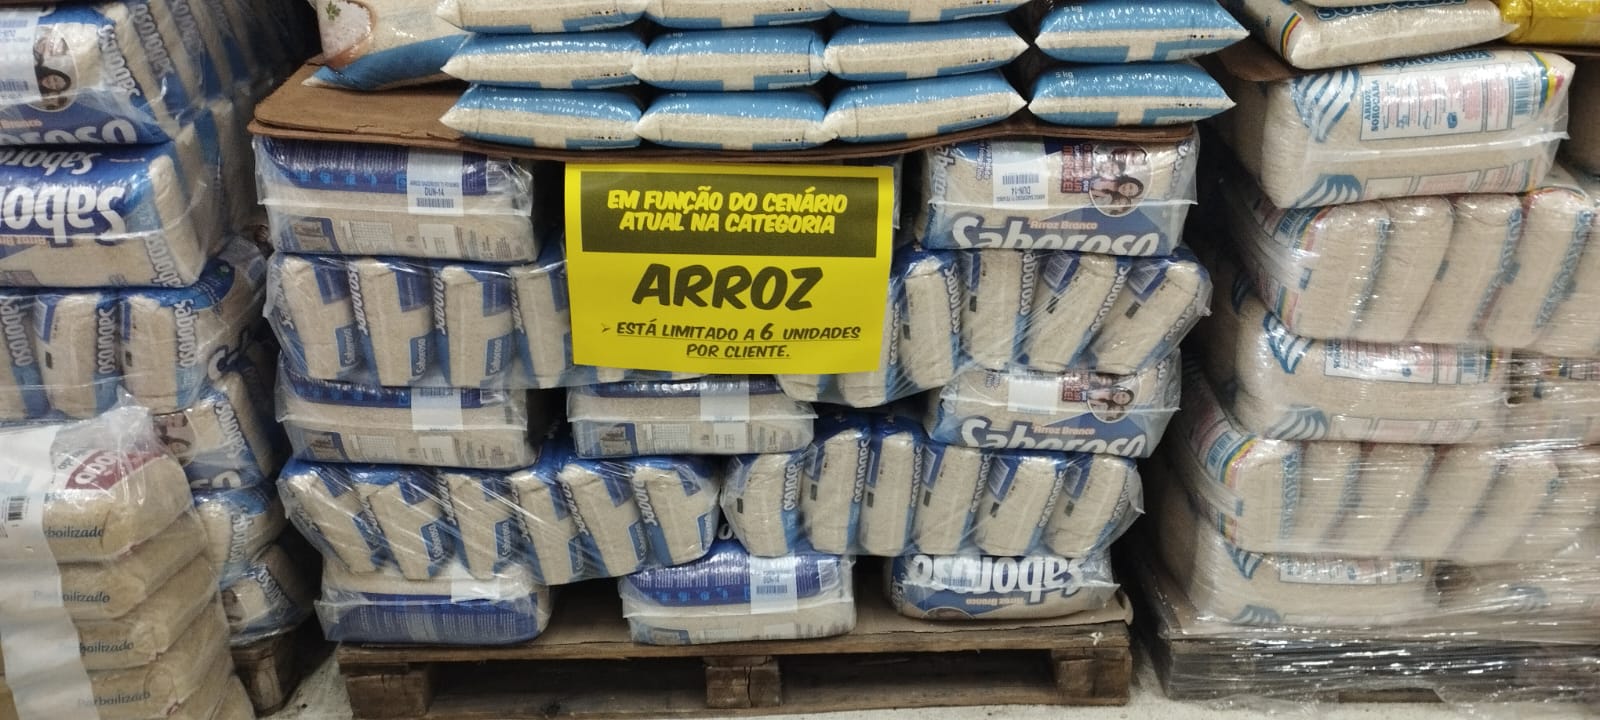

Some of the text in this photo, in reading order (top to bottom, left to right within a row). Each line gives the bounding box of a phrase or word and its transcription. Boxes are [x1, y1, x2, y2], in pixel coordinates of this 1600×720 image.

[607, 186, 848, 215] EM FUNÇÃO DO CENÁRIO
[0, 186, 126, 244] Sabo
[619, 211, 836, 235] ATUAL NA CATEGORIA
[1030, 220, 1098, 231] Arroz Branco
[631, 263, 824, 311] ARROZ
[1020, 251, 1036, 316] aboroso
[174, 299, 198, 368] Saboroso
[616, 318, 861, 341] ESTÁ LIMITADO A 6 UNIDADES
[686, 343, 791, 359] POR CLIENTE.
[1033, 425, 1095, 436] Arroz Branco
